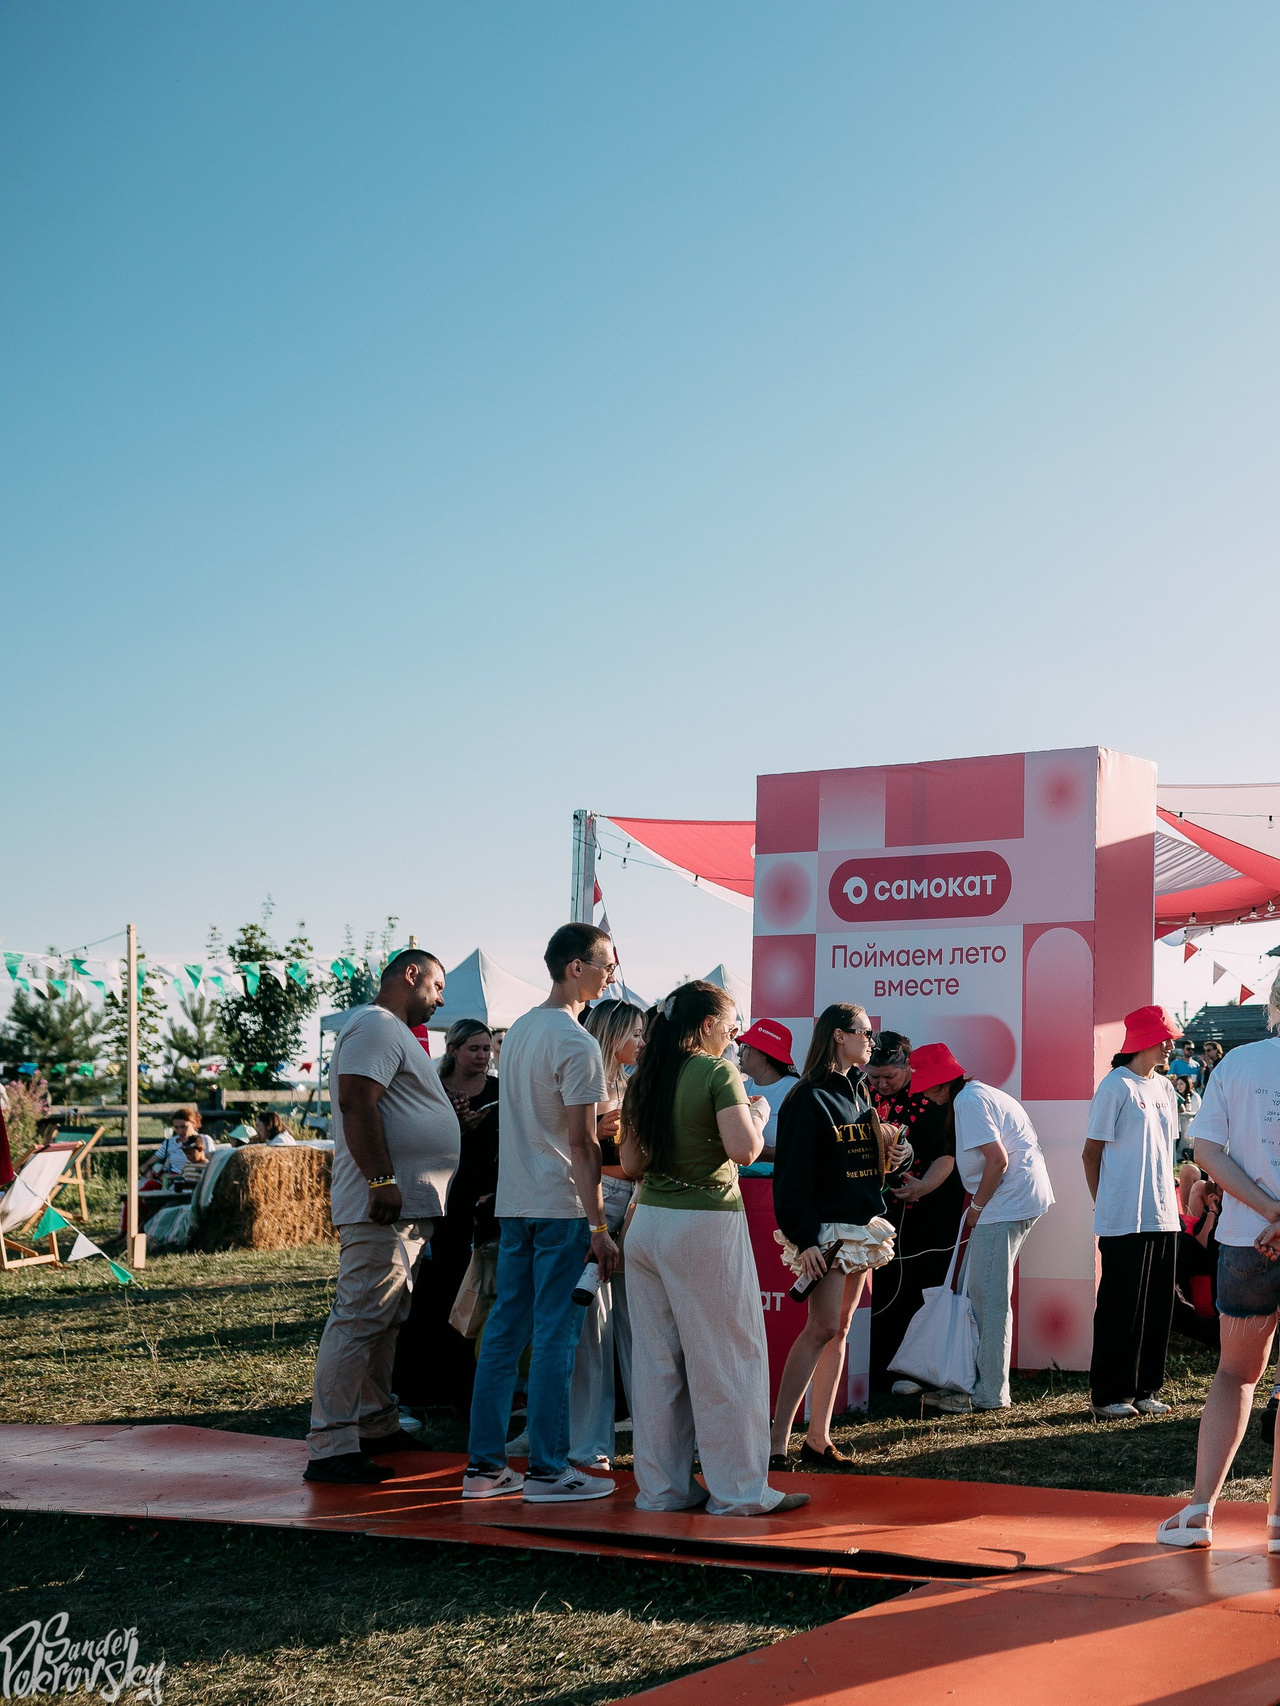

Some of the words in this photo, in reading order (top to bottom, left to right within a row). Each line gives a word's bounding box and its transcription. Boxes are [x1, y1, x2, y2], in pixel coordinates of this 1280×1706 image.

[874, 874, 997, 901] самокат
[831, 942, 943, 969] Поймаем
[949, 945, 1007, 966] лето
[874, 977, 960, 997] вместе
